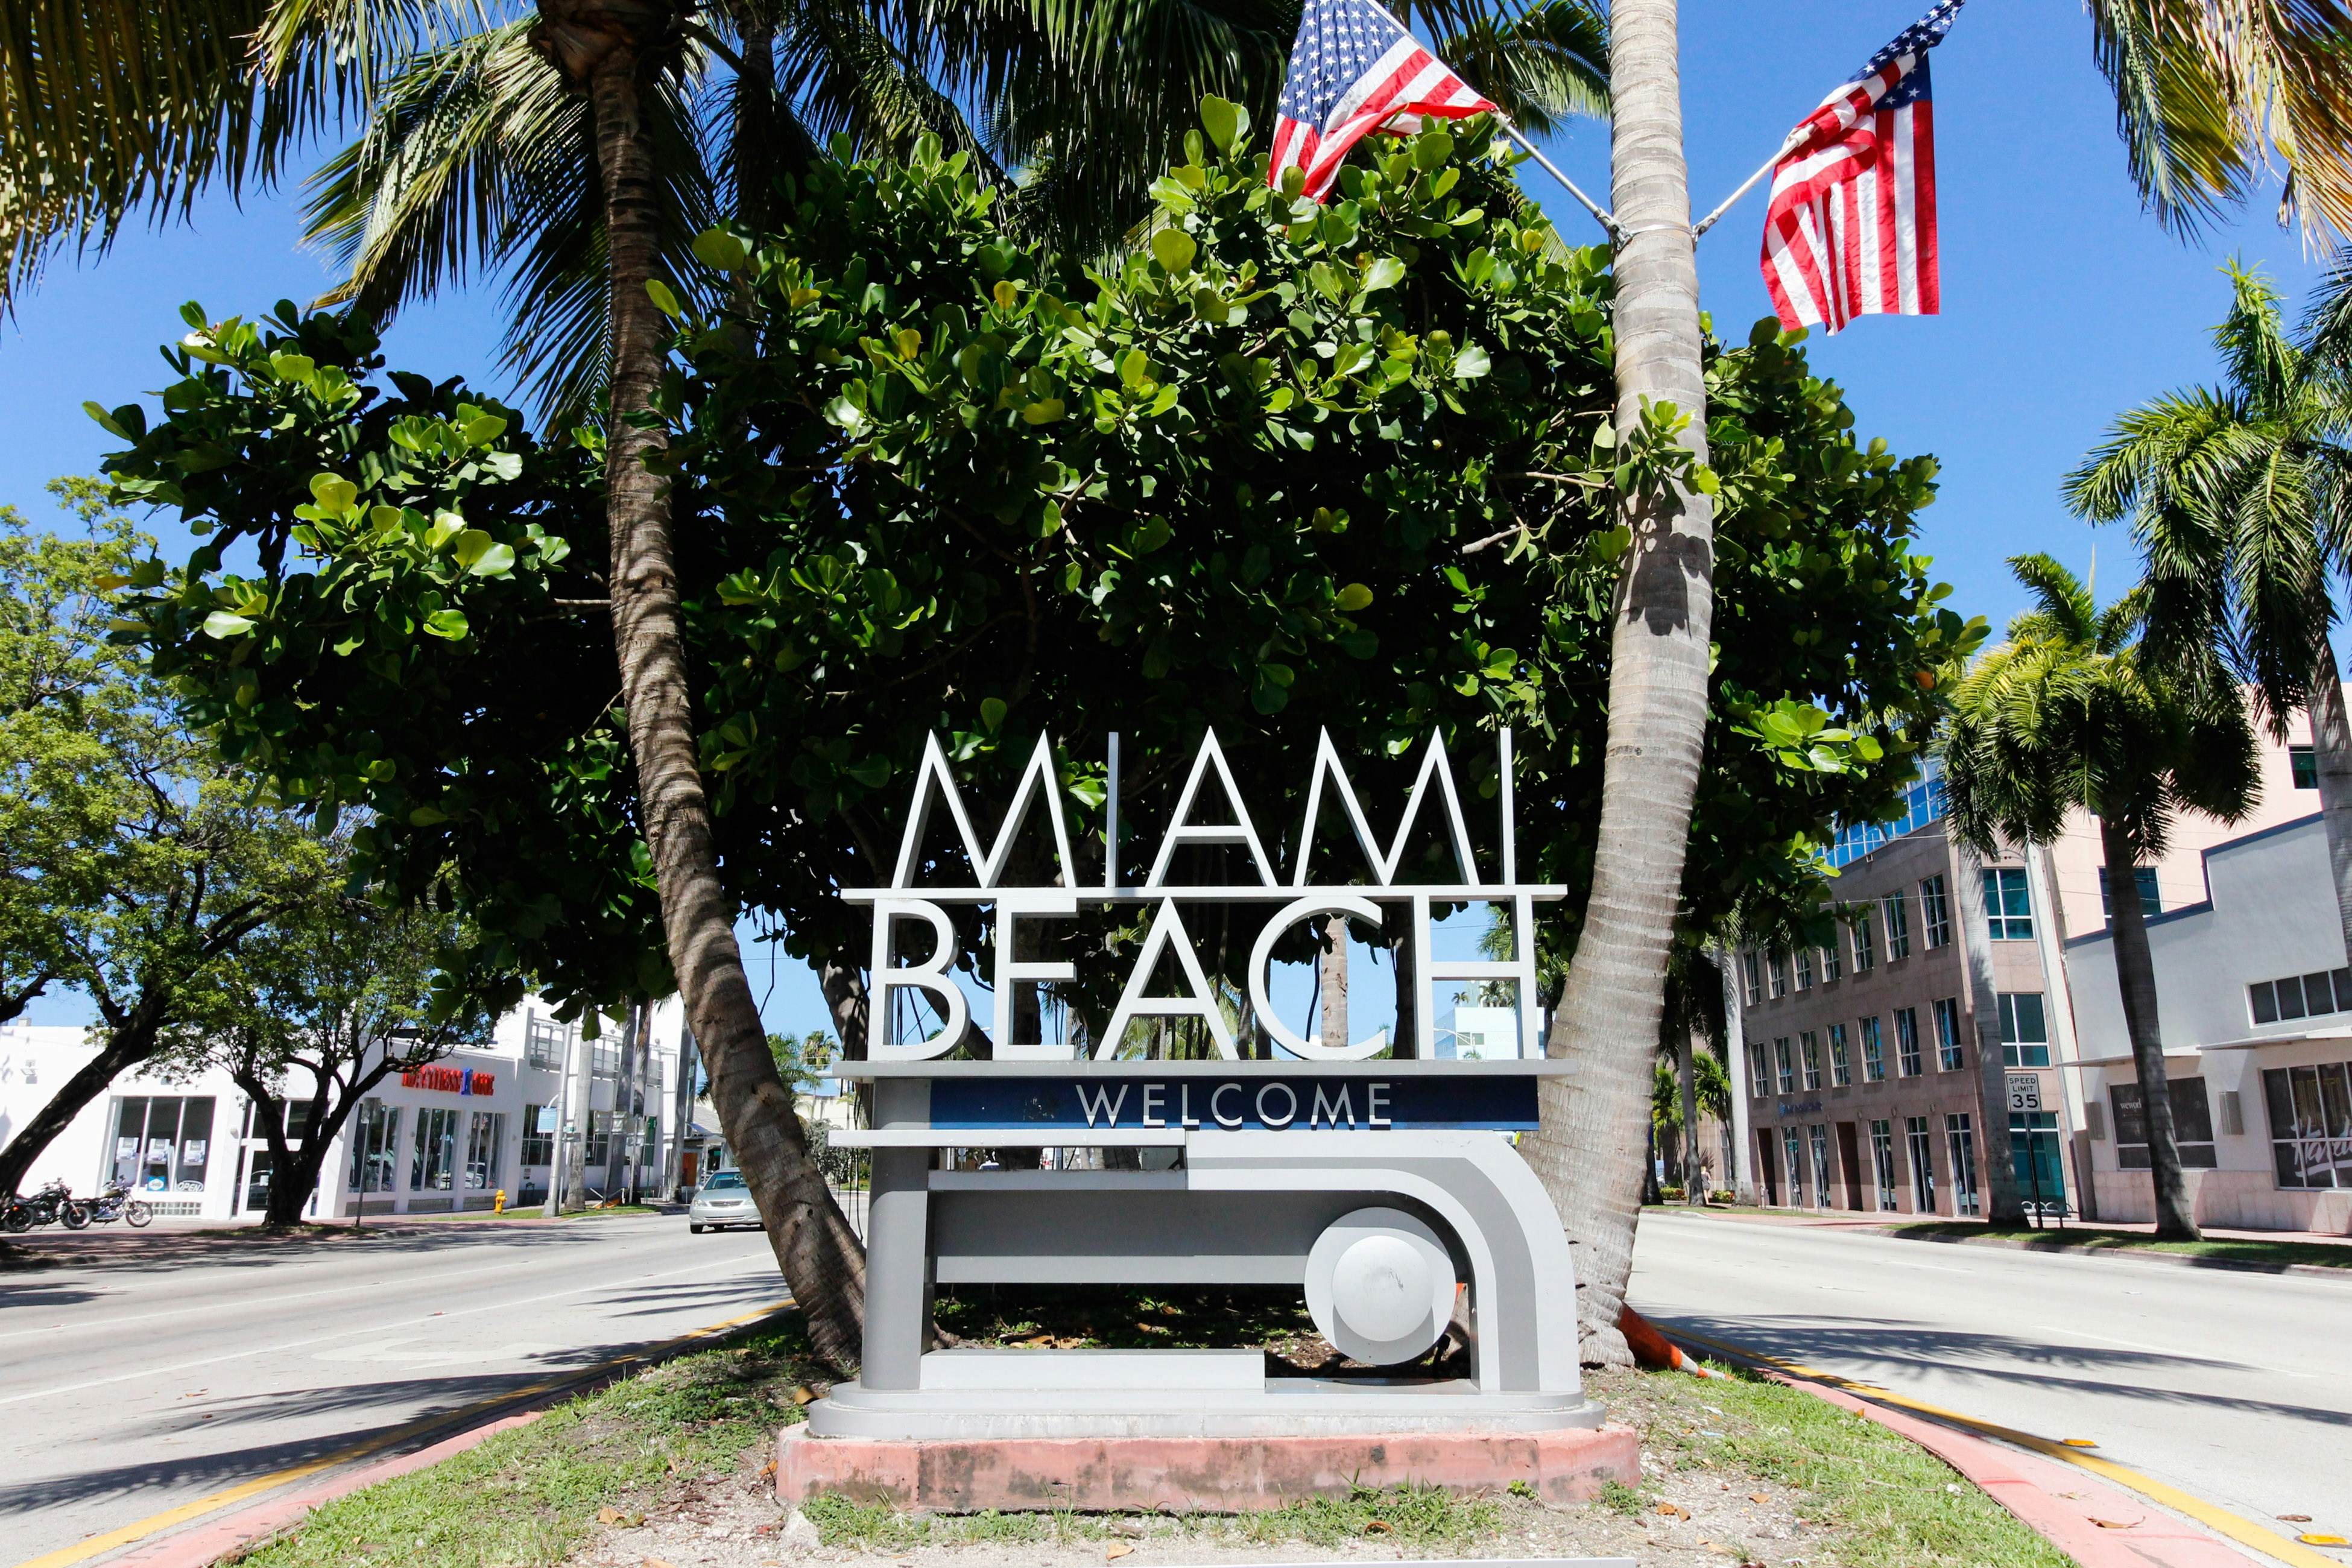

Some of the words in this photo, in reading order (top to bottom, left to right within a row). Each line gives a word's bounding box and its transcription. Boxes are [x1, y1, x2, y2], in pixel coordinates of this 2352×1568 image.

[891, 726, 1516, 888] MIAMI
[867, 894, 1537, 1061] BEACH
[1076, 1083, 1391, 1128] WELCOME
[2012, 1094, 2038, 1108] 35
[178, 1182, 201, 1192] OPEN
